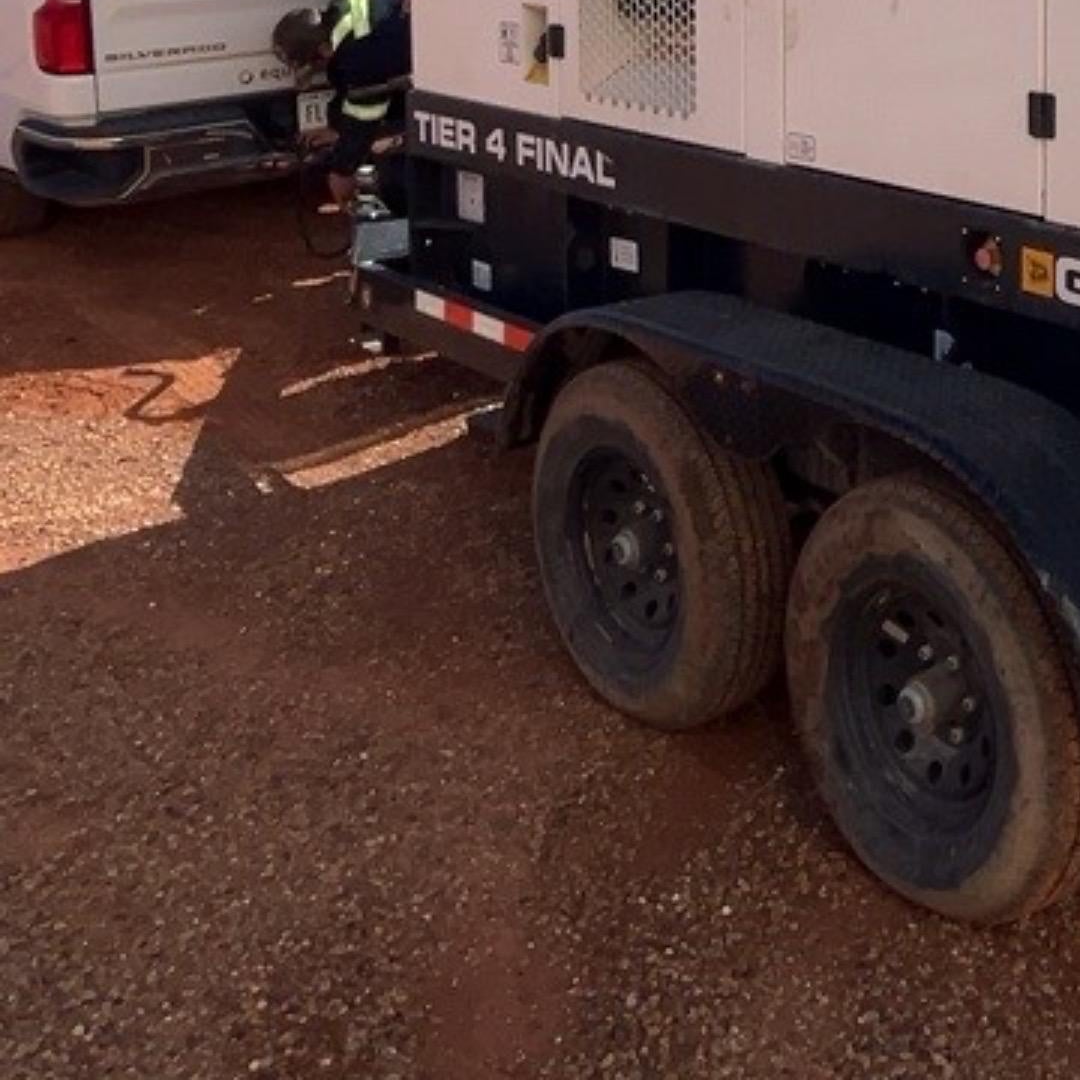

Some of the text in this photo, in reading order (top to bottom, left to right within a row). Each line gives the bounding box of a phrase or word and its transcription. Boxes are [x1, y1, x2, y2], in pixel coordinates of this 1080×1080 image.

[413, 109, 617, 190] TIER 4 FINAL
